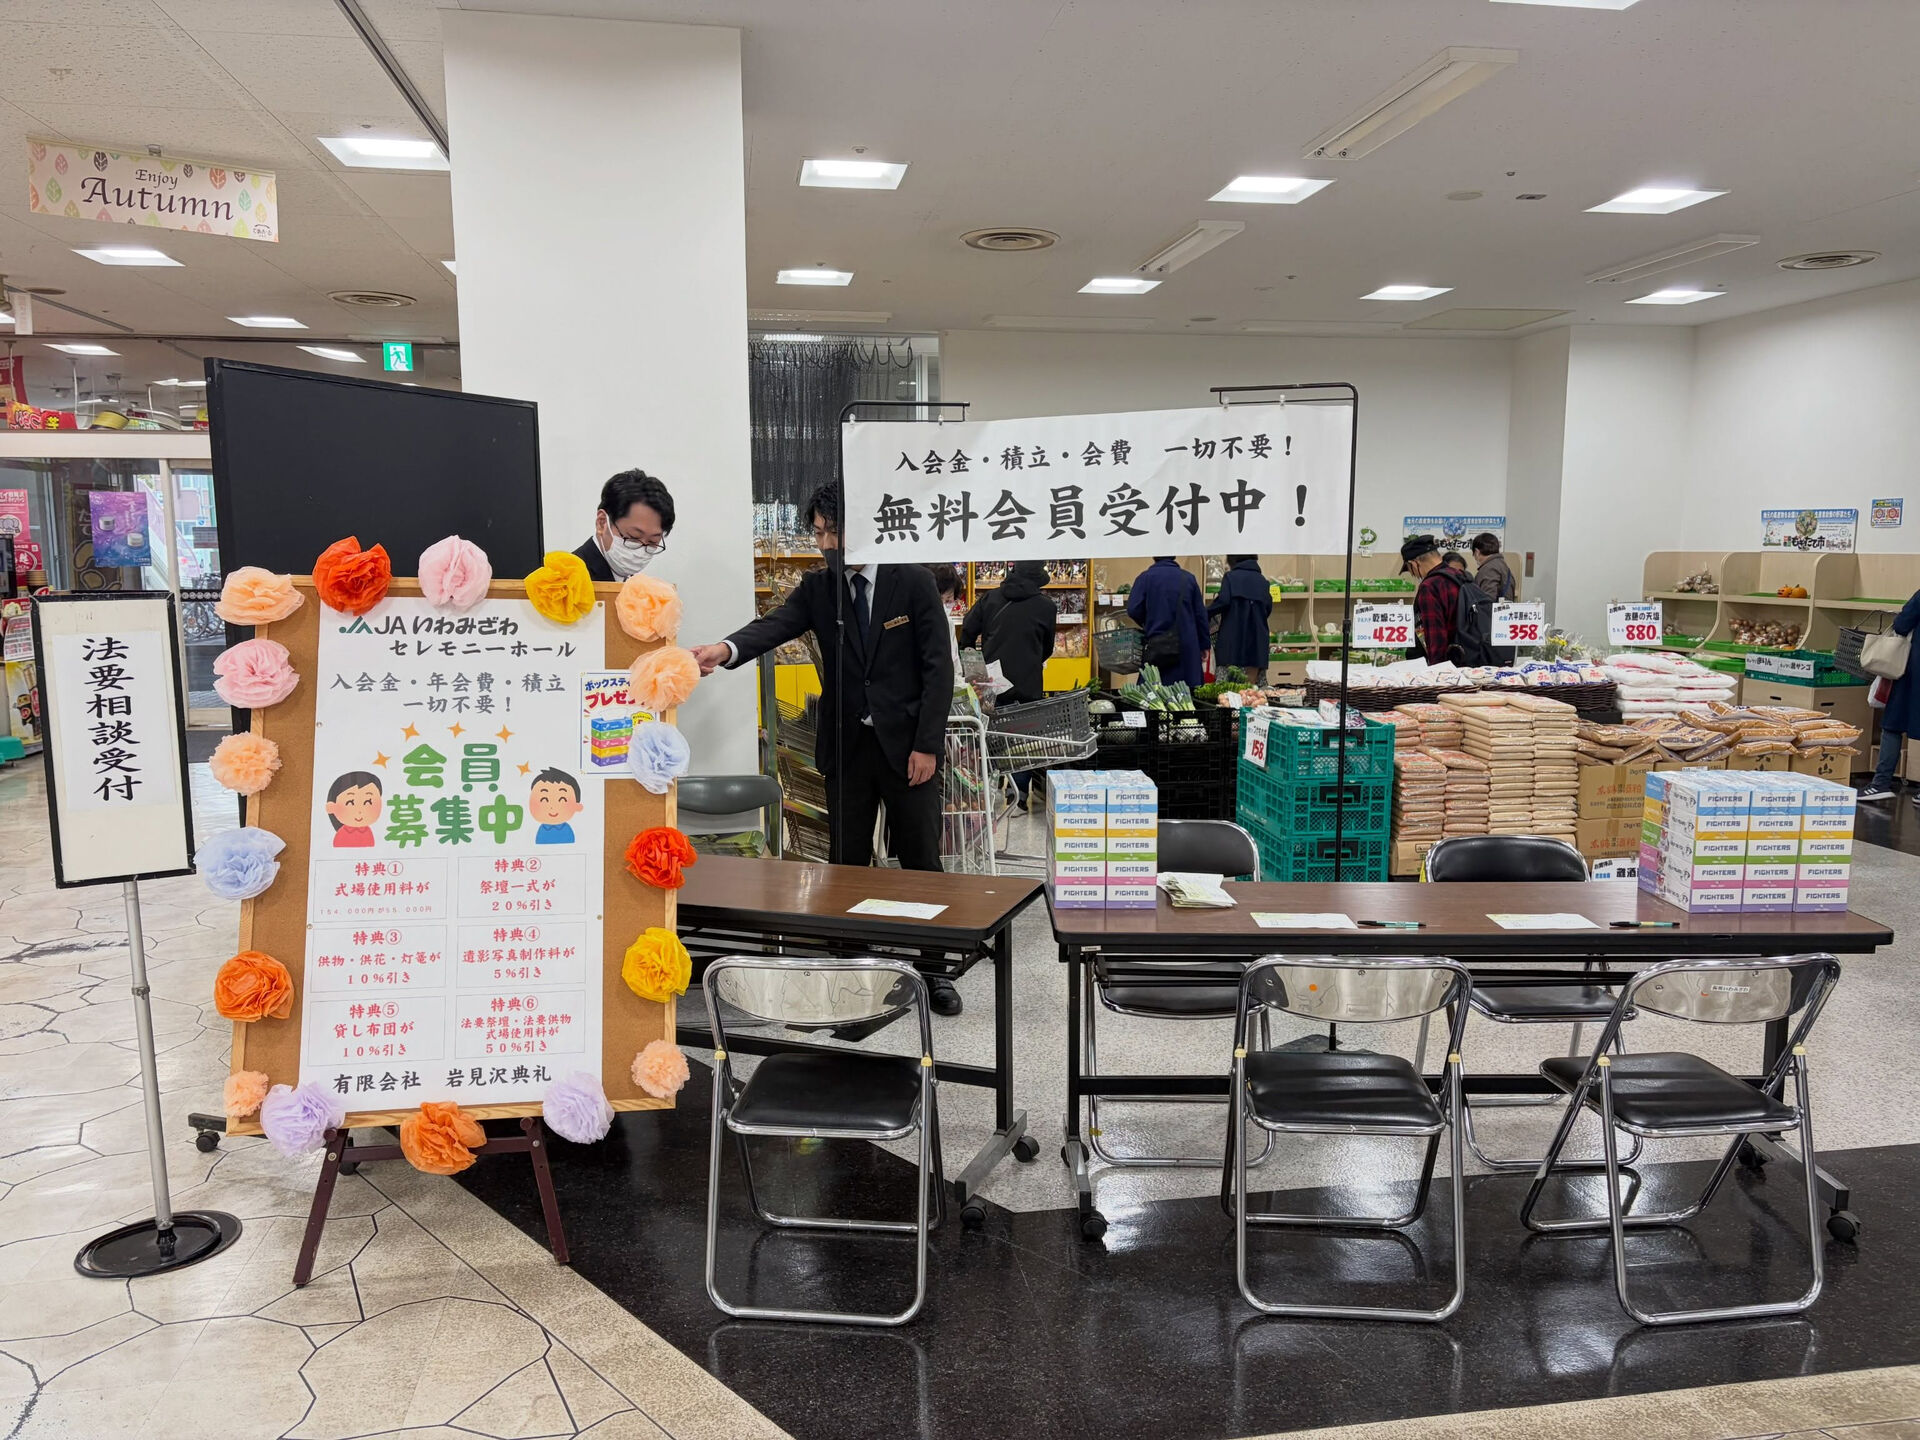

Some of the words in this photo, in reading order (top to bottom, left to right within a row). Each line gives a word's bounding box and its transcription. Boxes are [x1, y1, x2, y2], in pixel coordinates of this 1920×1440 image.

[135, 168, 178, 191] Enjoy
[81, 176, 233, 221] Autumn
[896, 439, 1131, 474] 入会金・積立・会費
[1165, 434, 1291, 459] 一切不要！
[873, 479, 1307, 544] 無料会員受付中！
[1373, 626, 1408, 642] 428
[1509, 624, 1538, 640] 358
[1626, 624, 1657, 640] 880
[390, 640, 576, 657] セレモニーホール
[331, 672, 565, 692] 入会金・年会費・積立
[403, 695, 510, 714] 一切不要！
[83, 637, 142, 801] 法要相談受付
[1252, 739, 1264, 760] 158
[403, 744, 500, 792] 会員
[1063, 793, 1099, 801] FIGHTERS
[1115, 793, 1150, 801] FIGHTERS
[1707, 795, 1743, 803] FIGHTERS
[1760, 795, 1796, 803] FIGHTERS
[1814, 794, 1850, 802] FIGHTERS
[384, 794, 523, 848] 募集中
[1811, 819, 1847, 827] FIGHTERS
[1703, 844, 1739, 852] FIGHTERS
[1809, 843, 1845, 851] FIGHTERS
[1807, 868, 1843, 876] FIGHTERS
[335, 882, 429, 896] 式場使用料が
[481, 879, 555, 894] 祭壇一式が
[1699, 893, 1735, 901] FIGHTERS
[1751, 892, 1787, 900] FIGHTERS
[1805, 892, 1841, 900] FIGHTERS
[463, 947, 575, 963] 遺影写真制作料が
[334, 1021, 414, 1038] 貸し布団が
[461, 1014, 572, 1029] 法要祭壇・法要供物
[486, 1026, 558, 1040] 式場使用料が
[334, 1071, 421, 1094] 有限会社
[447, 1065, 551, 1087] 岩見沢典礼
